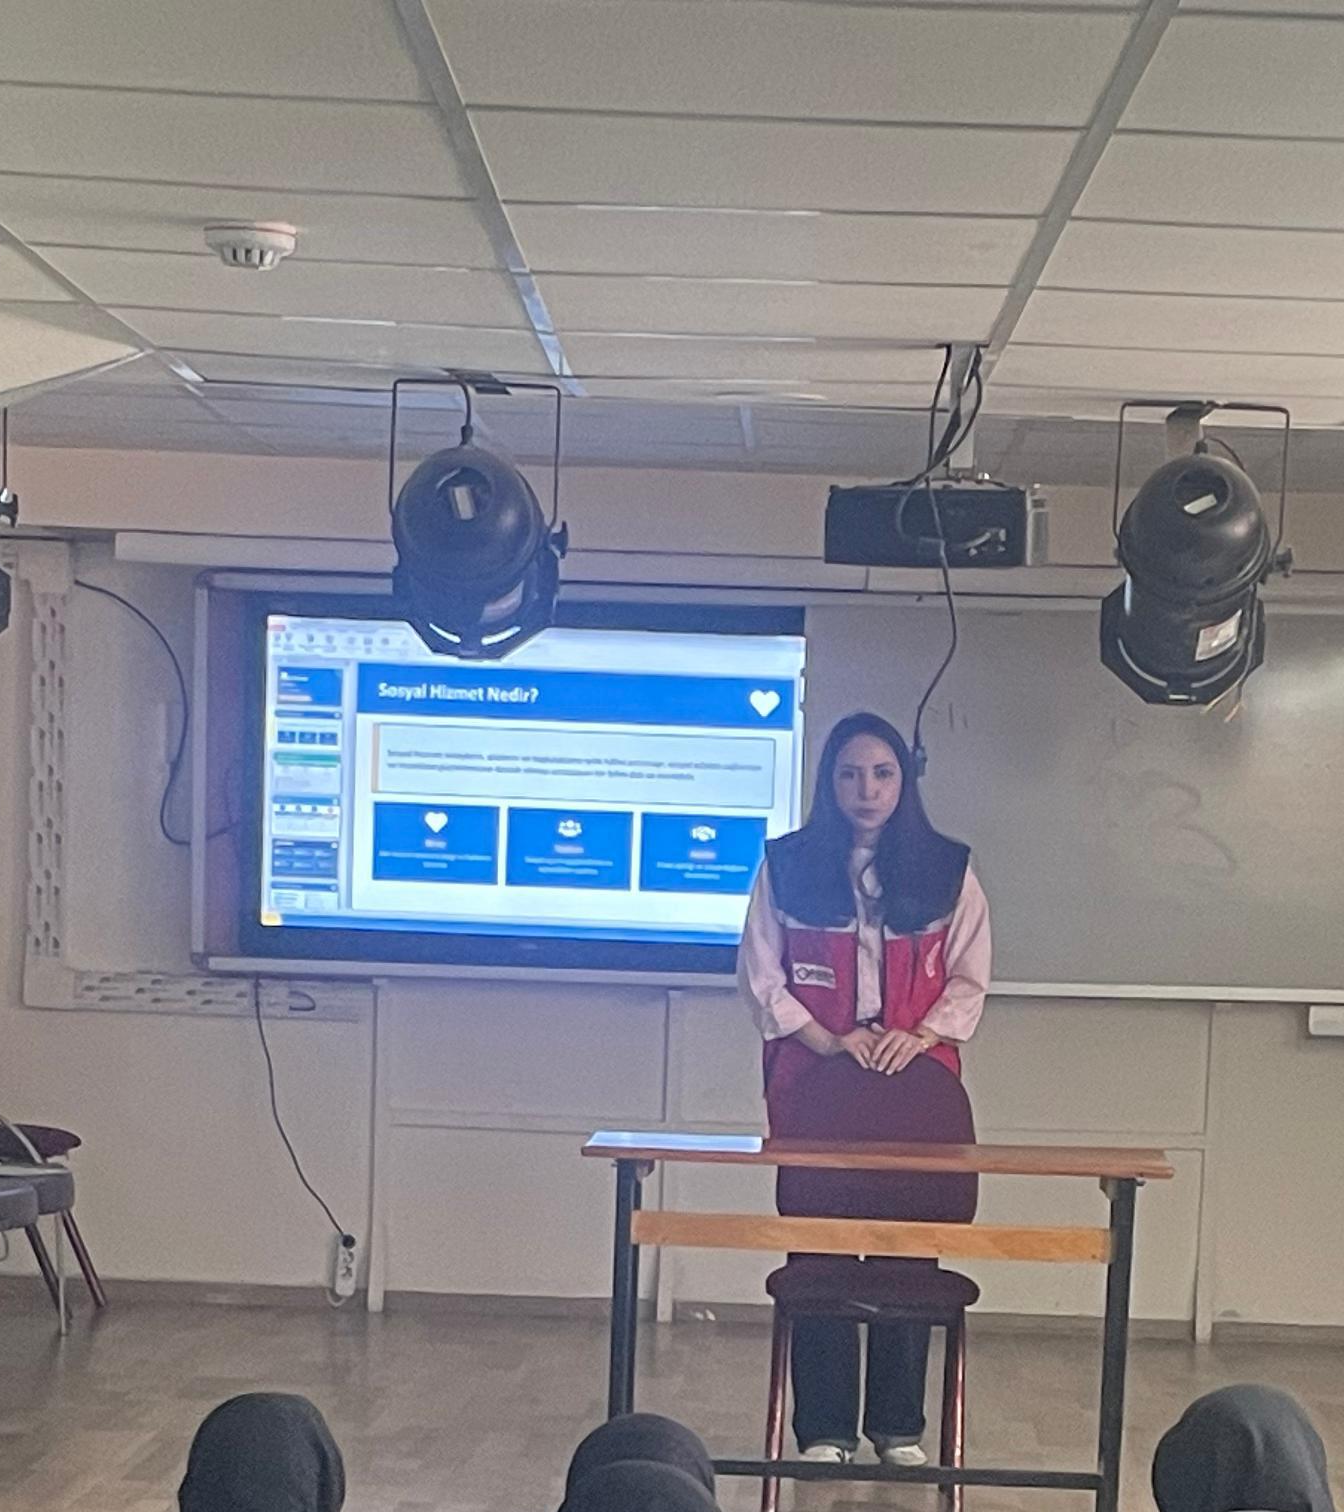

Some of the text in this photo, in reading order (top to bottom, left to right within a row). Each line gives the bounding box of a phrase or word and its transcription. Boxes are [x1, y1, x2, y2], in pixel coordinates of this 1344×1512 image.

[378, 682, 539, 703] Sosyal Hizmet Nedir?
